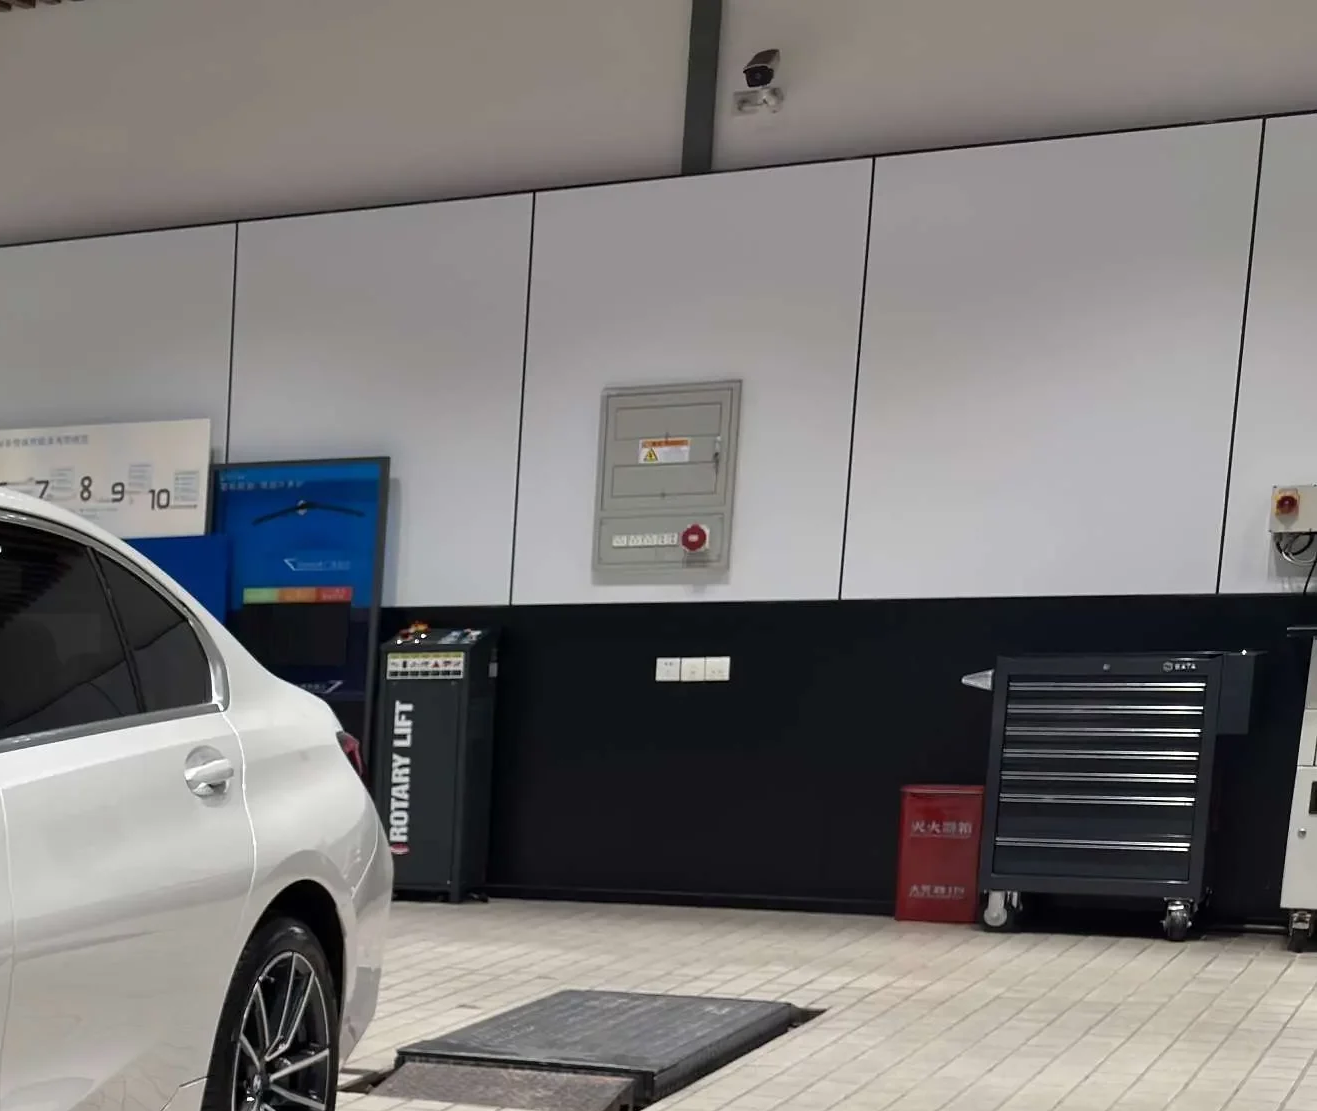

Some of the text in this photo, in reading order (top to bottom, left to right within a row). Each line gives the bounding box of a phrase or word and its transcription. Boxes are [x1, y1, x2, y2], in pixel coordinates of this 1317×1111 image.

[80, 475, 92, 502] 8
[111, 482, 125, 503] 9
[148, 488, 170, 510] 10
[389, 700, 414, 843] ROTARY LIFT
